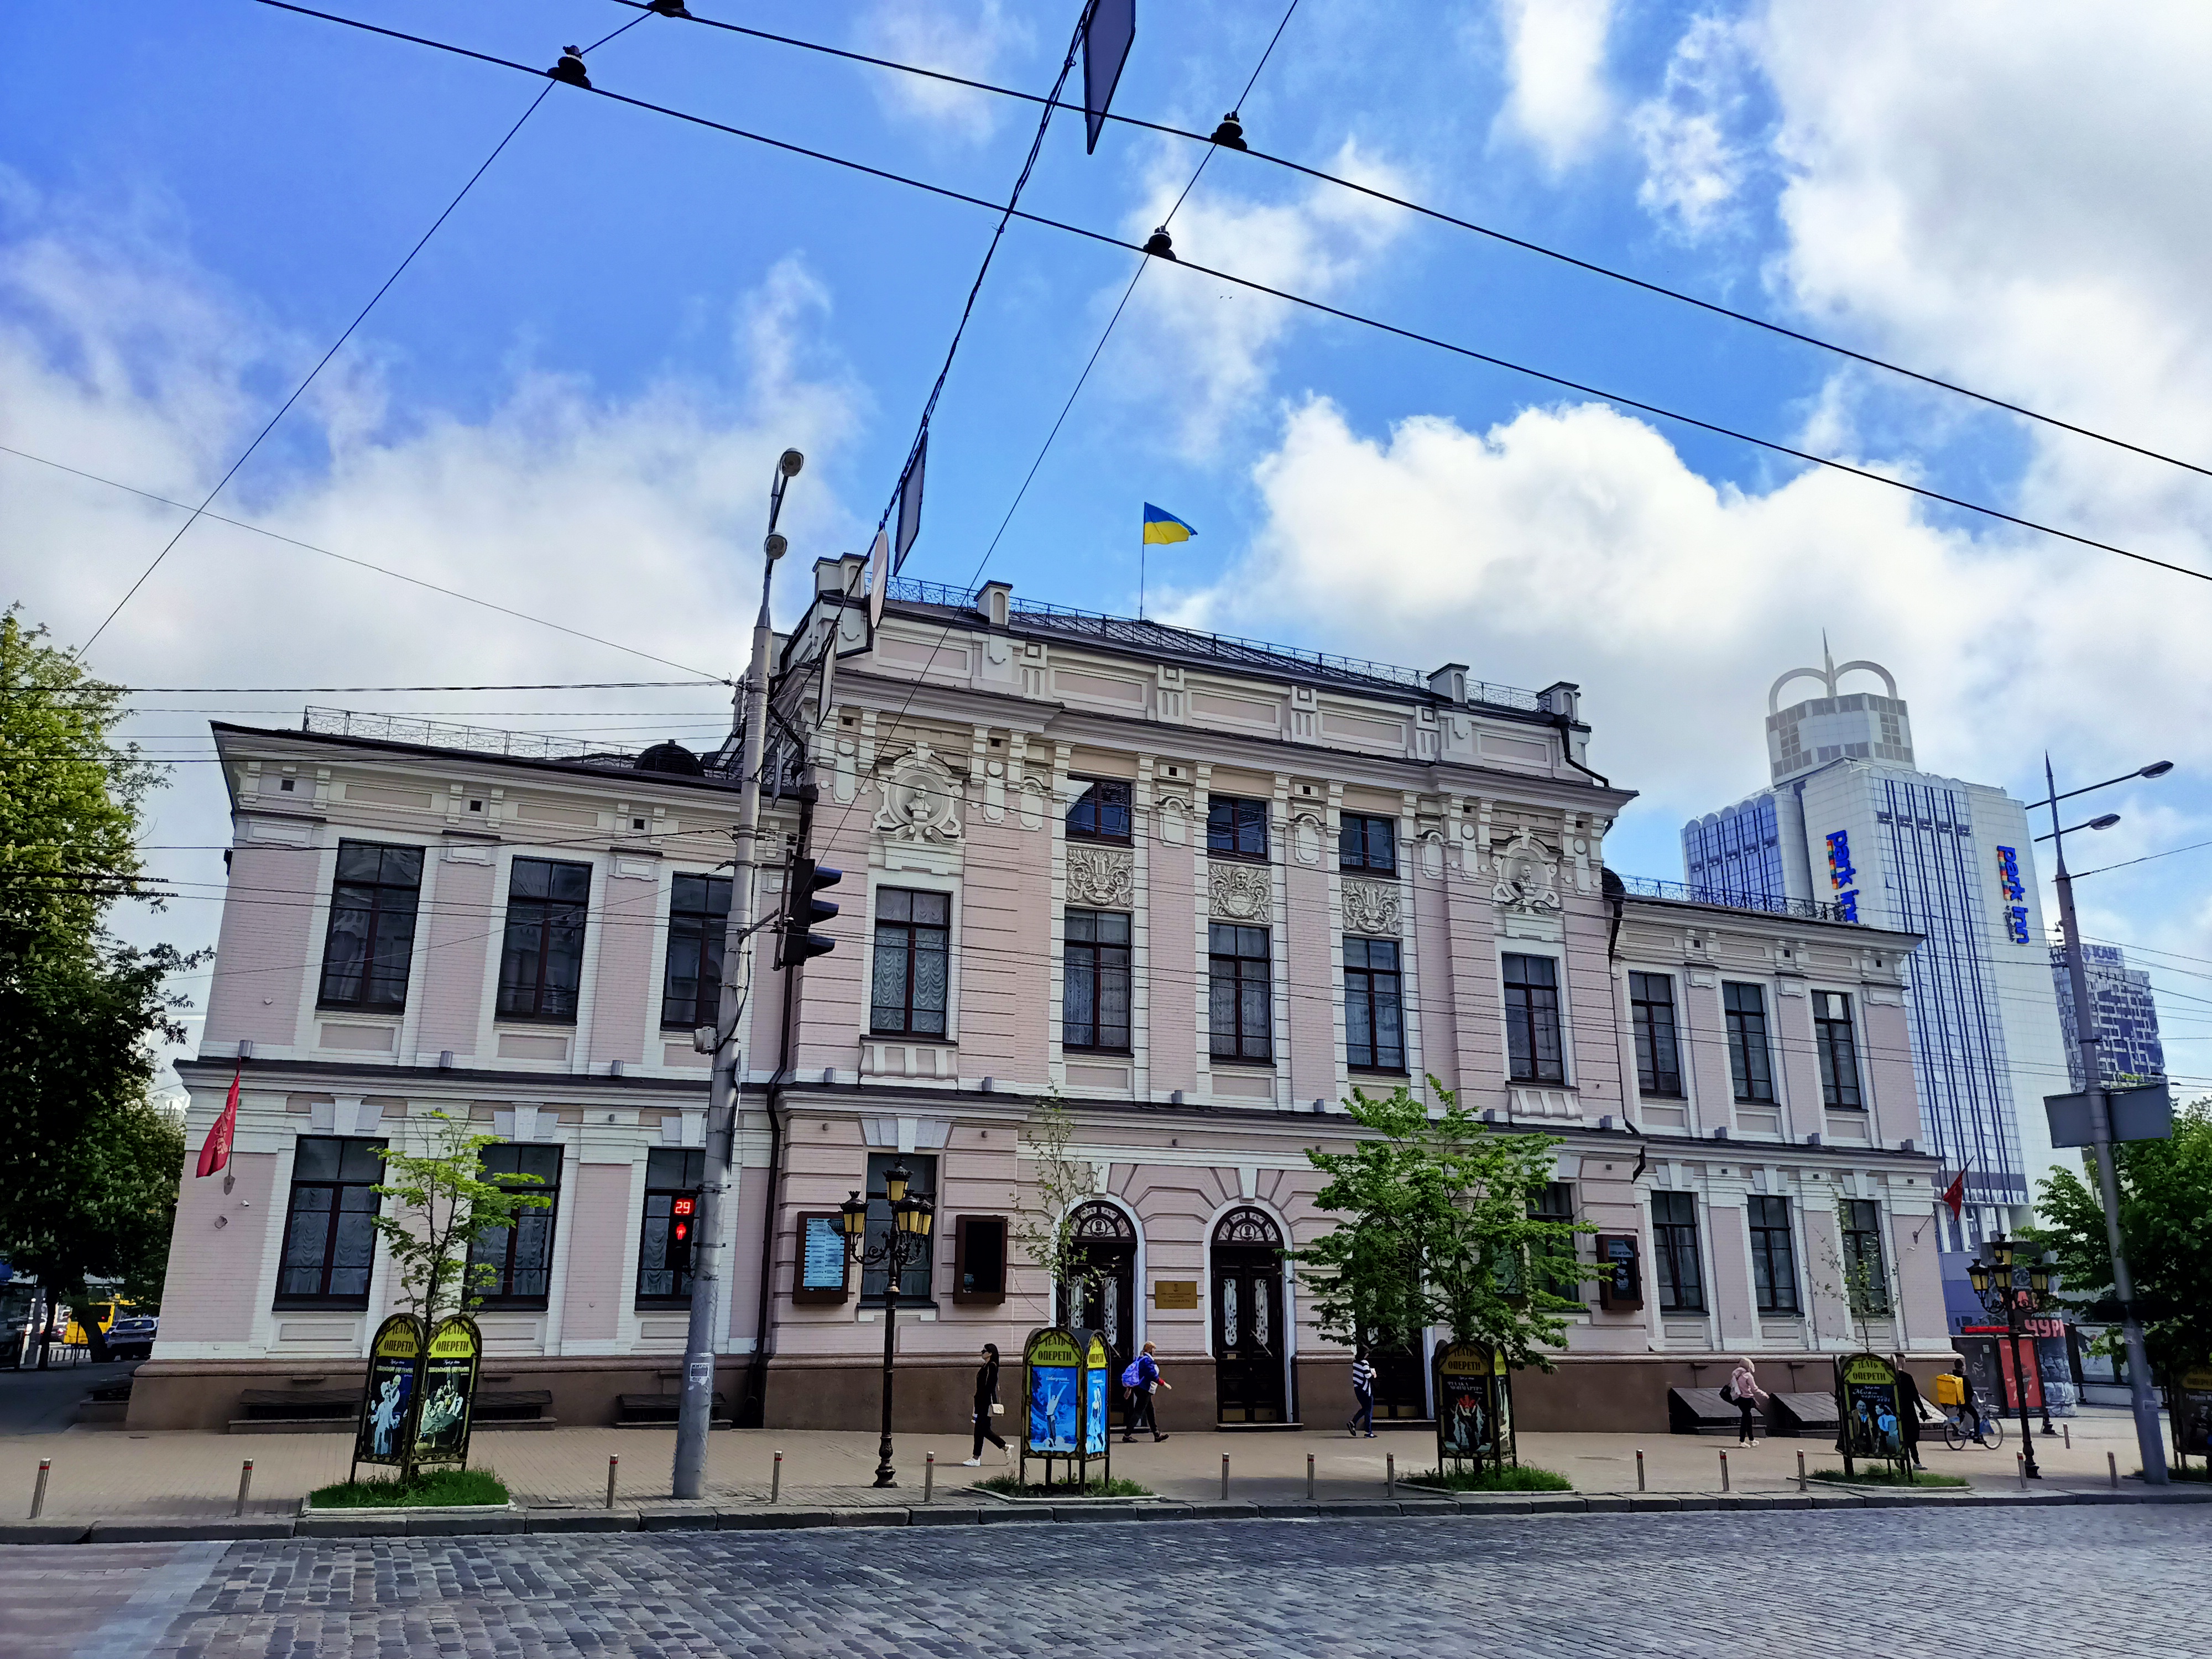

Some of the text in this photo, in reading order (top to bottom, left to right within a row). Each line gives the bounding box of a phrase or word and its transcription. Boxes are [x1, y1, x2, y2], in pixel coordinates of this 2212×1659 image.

[1825, 830, 1856, 889] park
[1997, 845, 2025, 901] park
[2012, 906, 2030, 944] inn
[675, 1202, 691, 1214] 29
[384, 1340, 414, 1353] ОПЕРЕТИ
[436, 1340, 469, 1352] ОПЕРЕТИ
[1037, 1350, 1072, 1361] ОПЕРЕТИ
[1448, 1361, 1481, 1371] ОПЕРЕТИ
[1853, 1372, 1886, 1380] ОПЕРЕТИ
